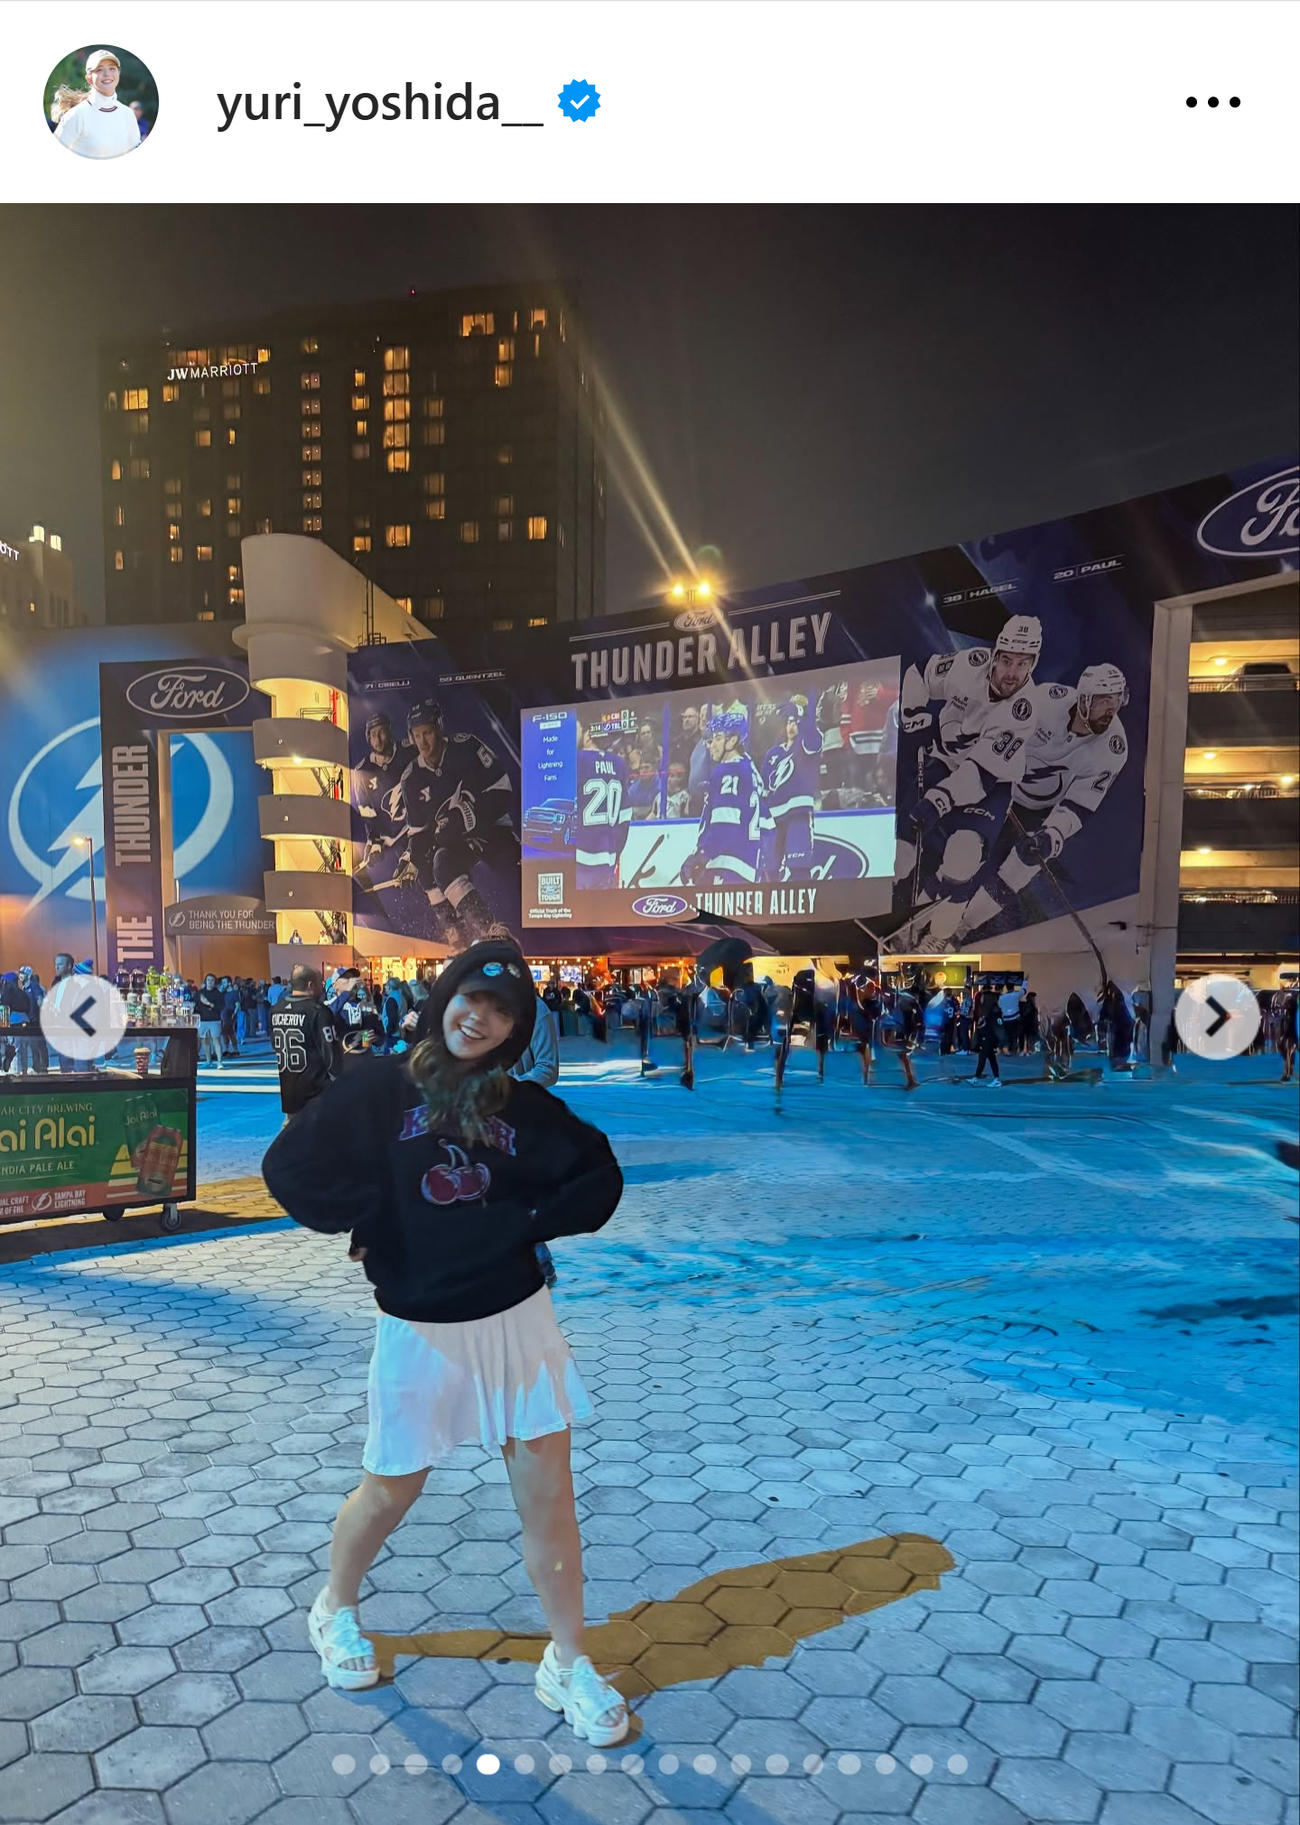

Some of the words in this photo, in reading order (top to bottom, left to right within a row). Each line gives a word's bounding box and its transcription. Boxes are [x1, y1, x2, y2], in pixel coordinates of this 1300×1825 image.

[190, 362, 258, 379] MARRIOTT
[1080, 559, 1123, 574] PAUL
[969, 583, 1018, 599] HAGEL
[571, 633, 718, 691] THUNDER
[727, 611, 833, 670] ALLEY
[150, 673, 227, 710] Ford
[595, 761, 616, 775] PAUL
[720, 774, 740, 795] 21
[112, 744, 151, 867] THUNDER
[582, 778, 623, 827] 20
[642, 897, 677, 914] Ford
[769, 888, 818, 915] ALLEY
[189, 910, 218, 919] THANK
[219, 910, 236, 919] YOU
[237, 910, 254, 919] FOR
[189, 920, 215, 930] BEING
[217, 920, 233, 930] THE
[234, 920, 275, 930] THUNDER
[116, 915, 154, 963] THE
[18, 1104, 44, 1115] CITY
[47, 1102, 93, 1114] BREWING
[34, 1115, 96, 1150] Alai
[29, 1163, 52, 1174] PALE
[56, 1160, 75, 1170] ALE
[10, 1196, 29, 1205] CRAFT
[54, 1191, 74, 1201] TAMPA
[74, 1189, 86, 1199] BAY
[54, 1198, 86, 1209] LIGHTNING
